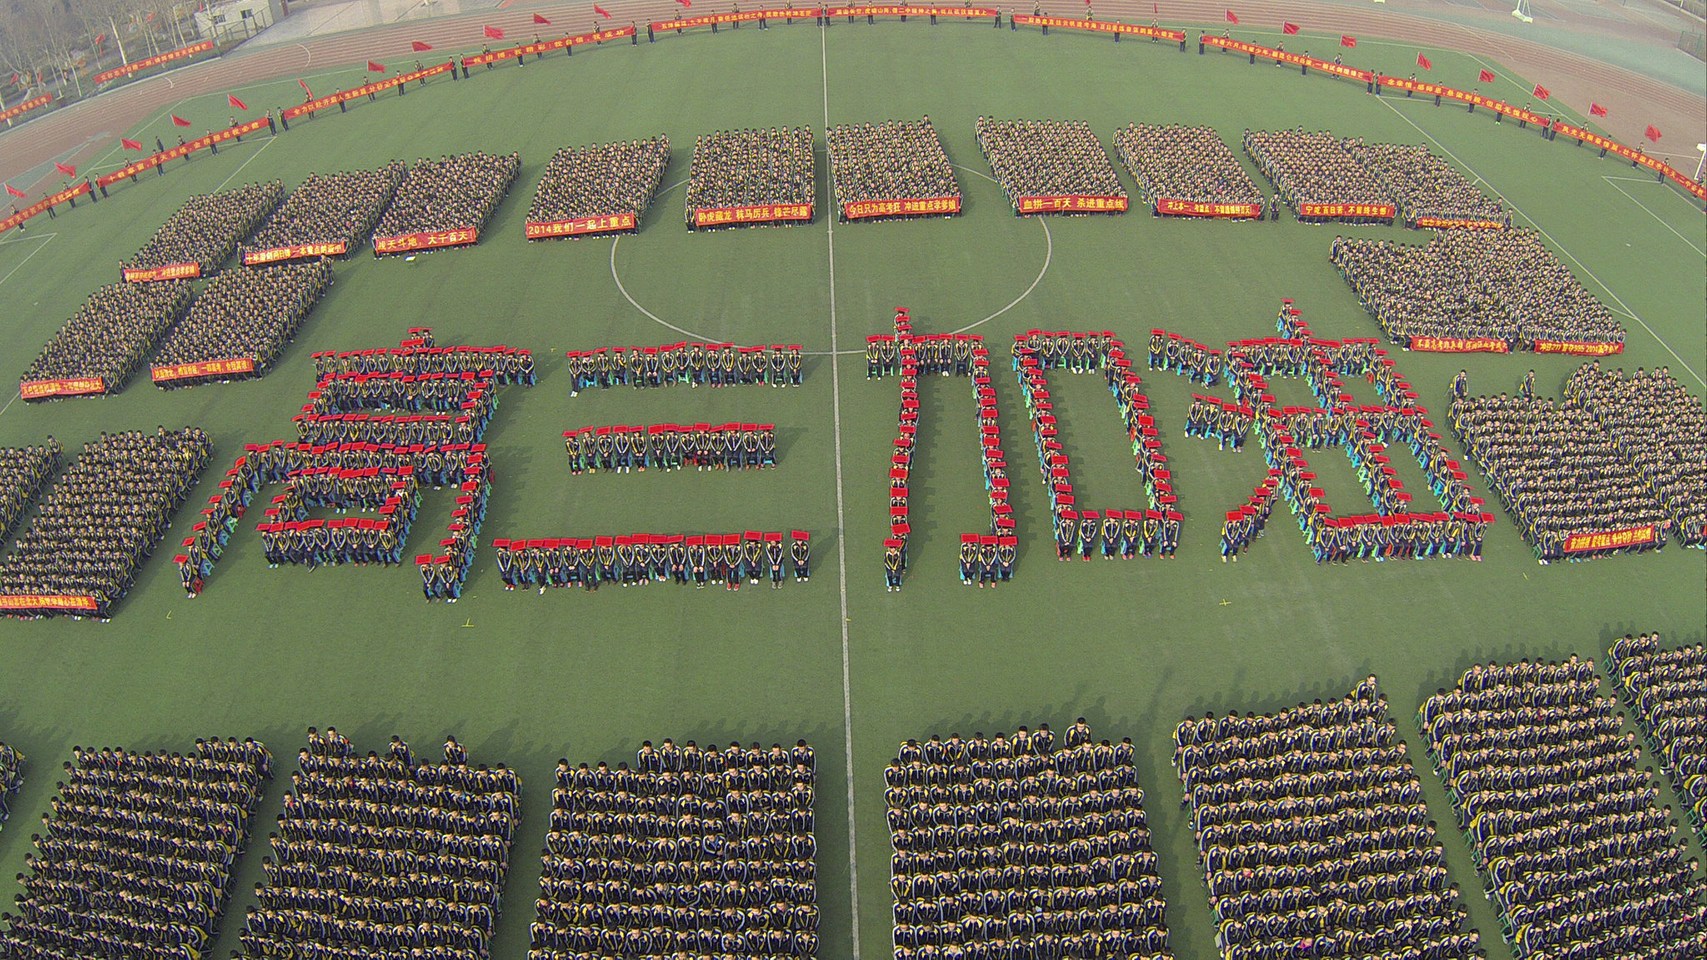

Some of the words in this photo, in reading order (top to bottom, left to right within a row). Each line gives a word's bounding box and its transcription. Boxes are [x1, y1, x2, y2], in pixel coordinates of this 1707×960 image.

[849, 202, 901, 215] 今日只为高考狂
[1023, 197, 1072, 210] 血拼一百天
[1077, 198, 1124, 209] 杀进重点线
[698, 211, 732, 223] 卧虎藏龙
[736, 208, 769, 221] 秣马厉兵
[528, 216, 632, 235] 2014我们一起上重点
